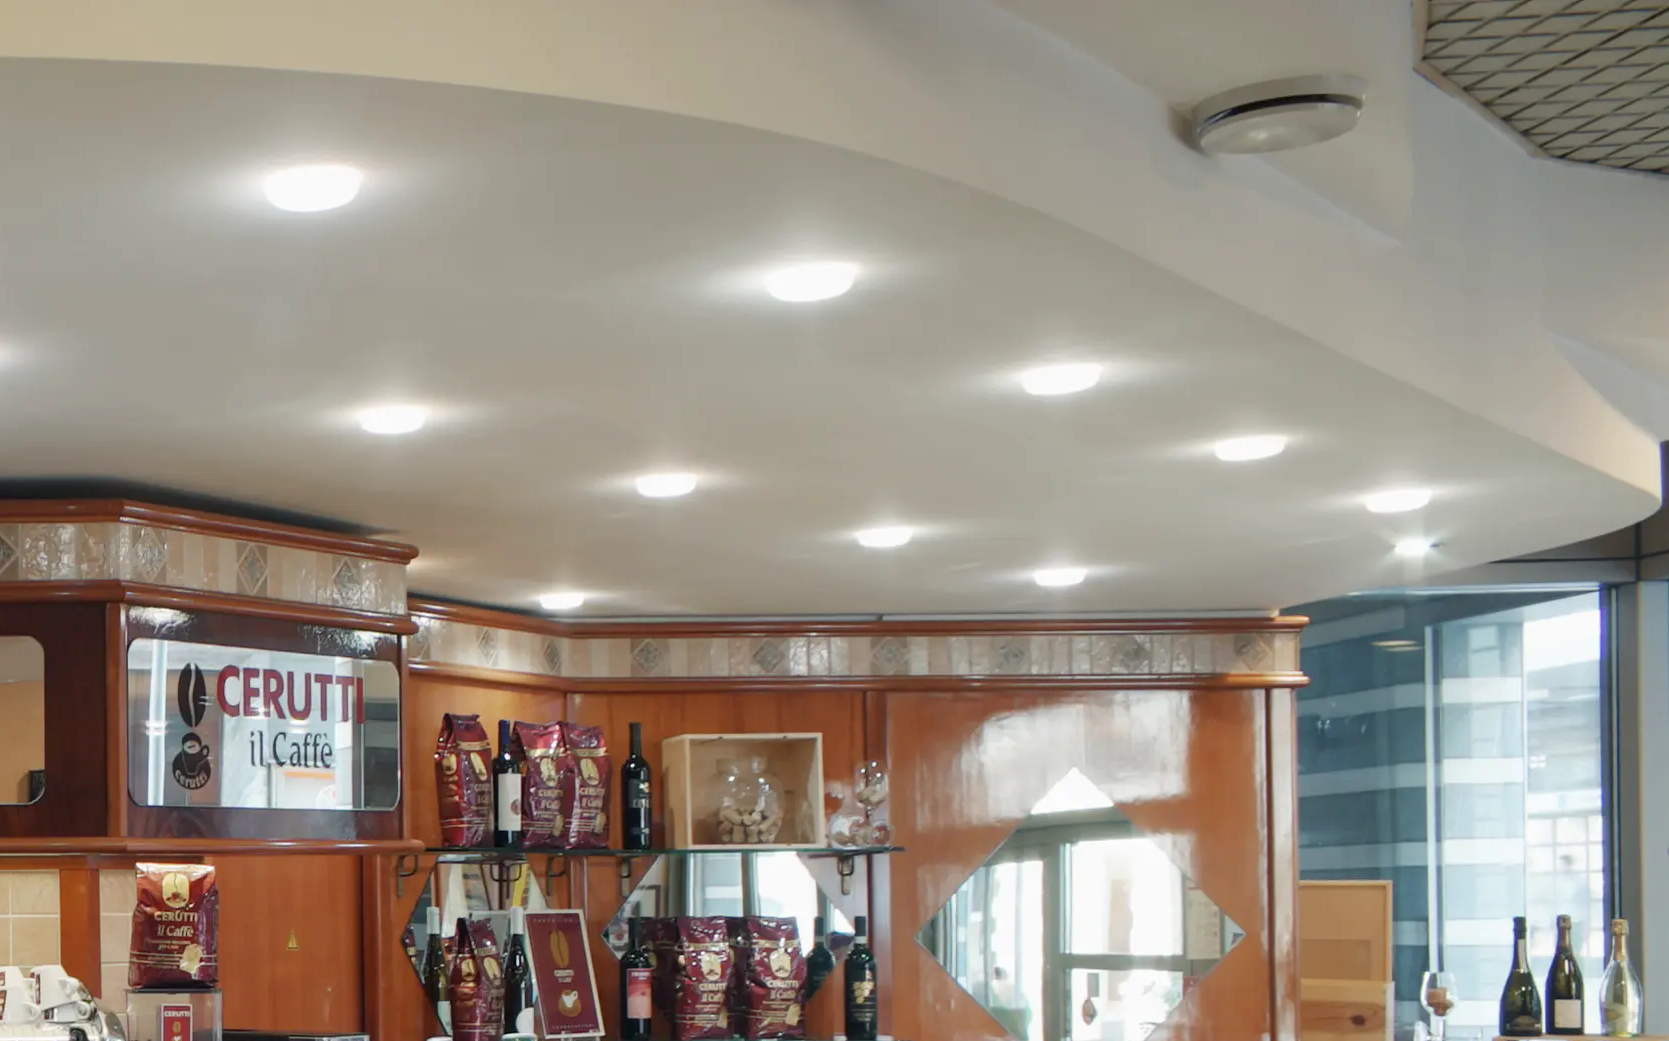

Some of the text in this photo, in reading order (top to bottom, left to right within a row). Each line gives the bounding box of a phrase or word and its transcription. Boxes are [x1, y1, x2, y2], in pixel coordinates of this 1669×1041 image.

[216, 664, 366, 725] CERUTTI
[250, 730, 334, 769] il Caffè
[174, 769, 208, 790] cerutti
[154, 910, 198, 922] CERUTTI
